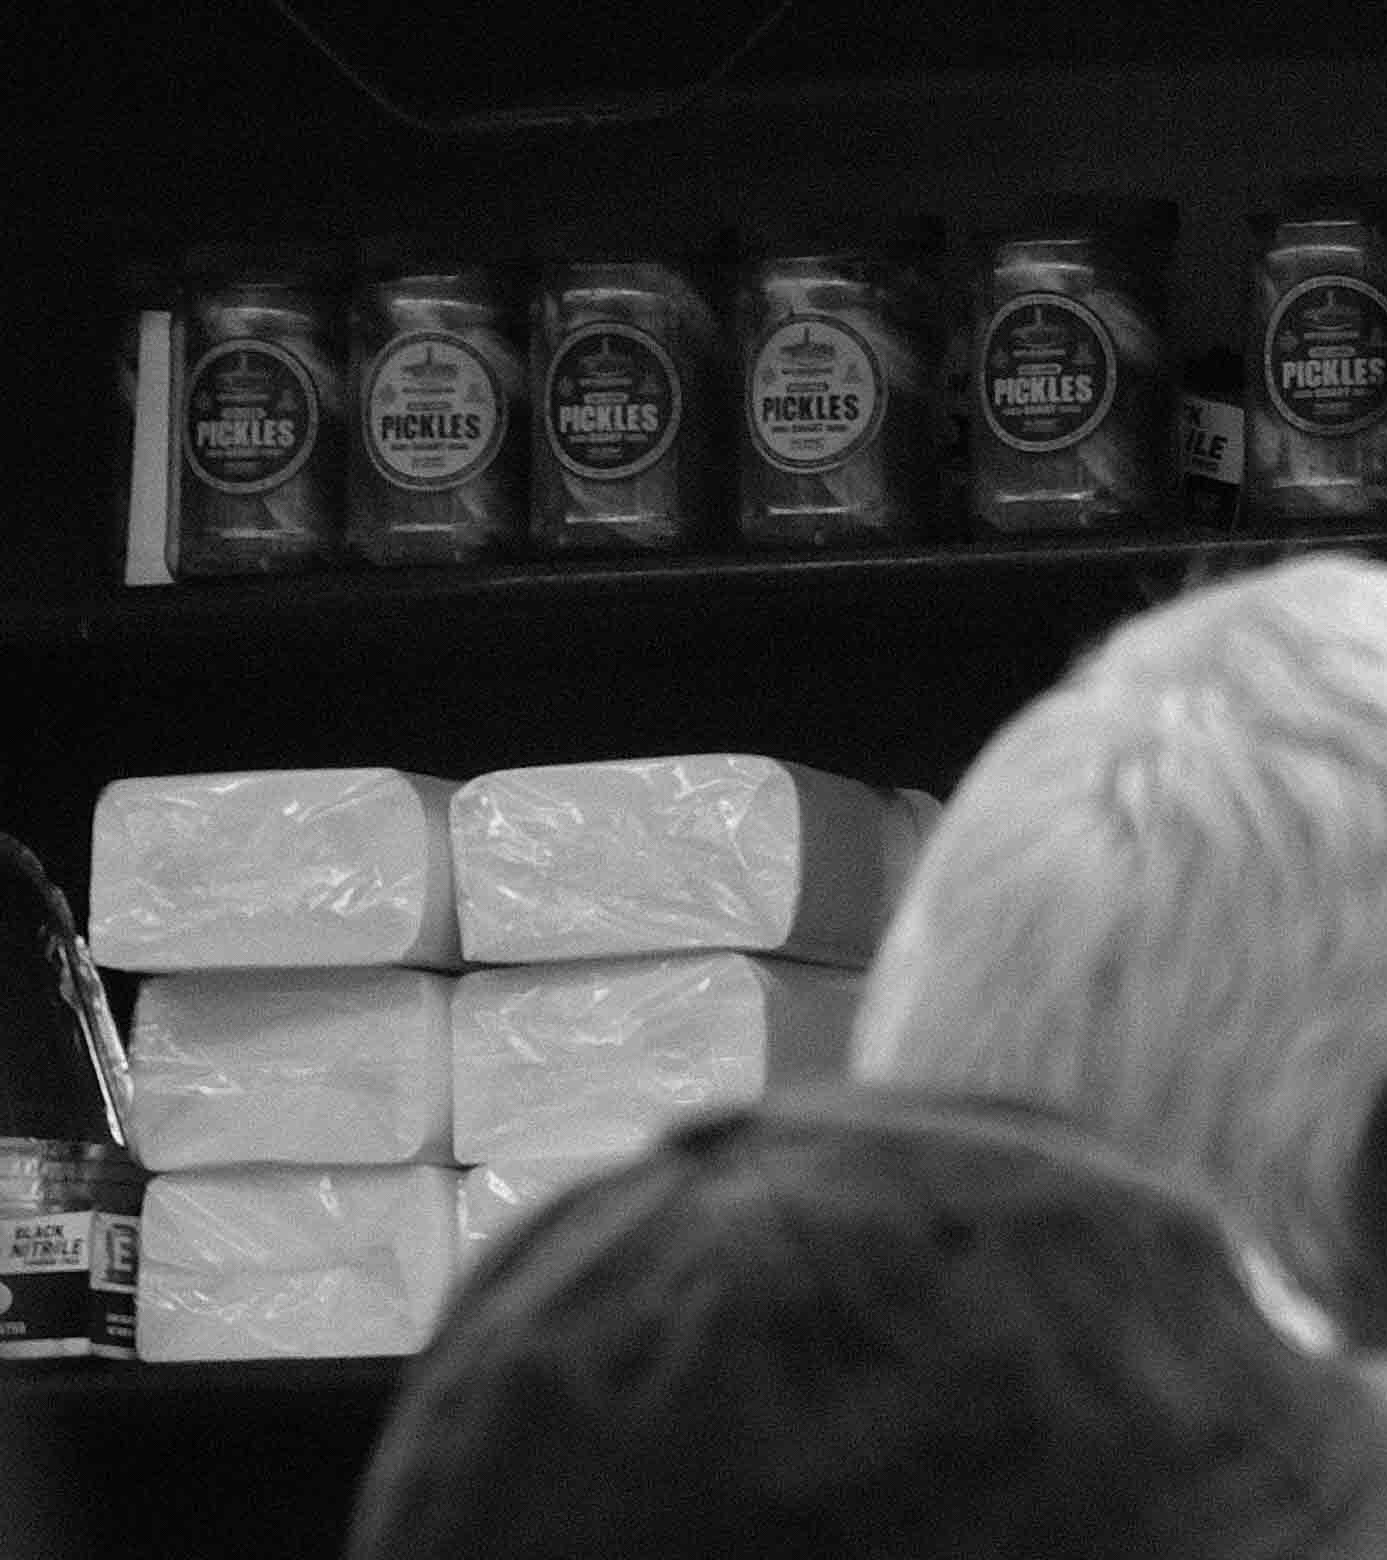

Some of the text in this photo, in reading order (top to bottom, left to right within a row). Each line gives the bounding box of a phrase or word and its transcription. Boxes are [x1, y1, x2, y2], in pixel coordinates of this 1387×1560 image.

[1281, 356, 1387, 391] PICKLES
[993, 374, 1094, 405] PICKLES
[558, 403, 659, 434] PICKLES
[762, 393, 860, 424] PICKLES
[196, 419, 295, 448] PICKLES
[381, 413, 481, 442] PICKLES
